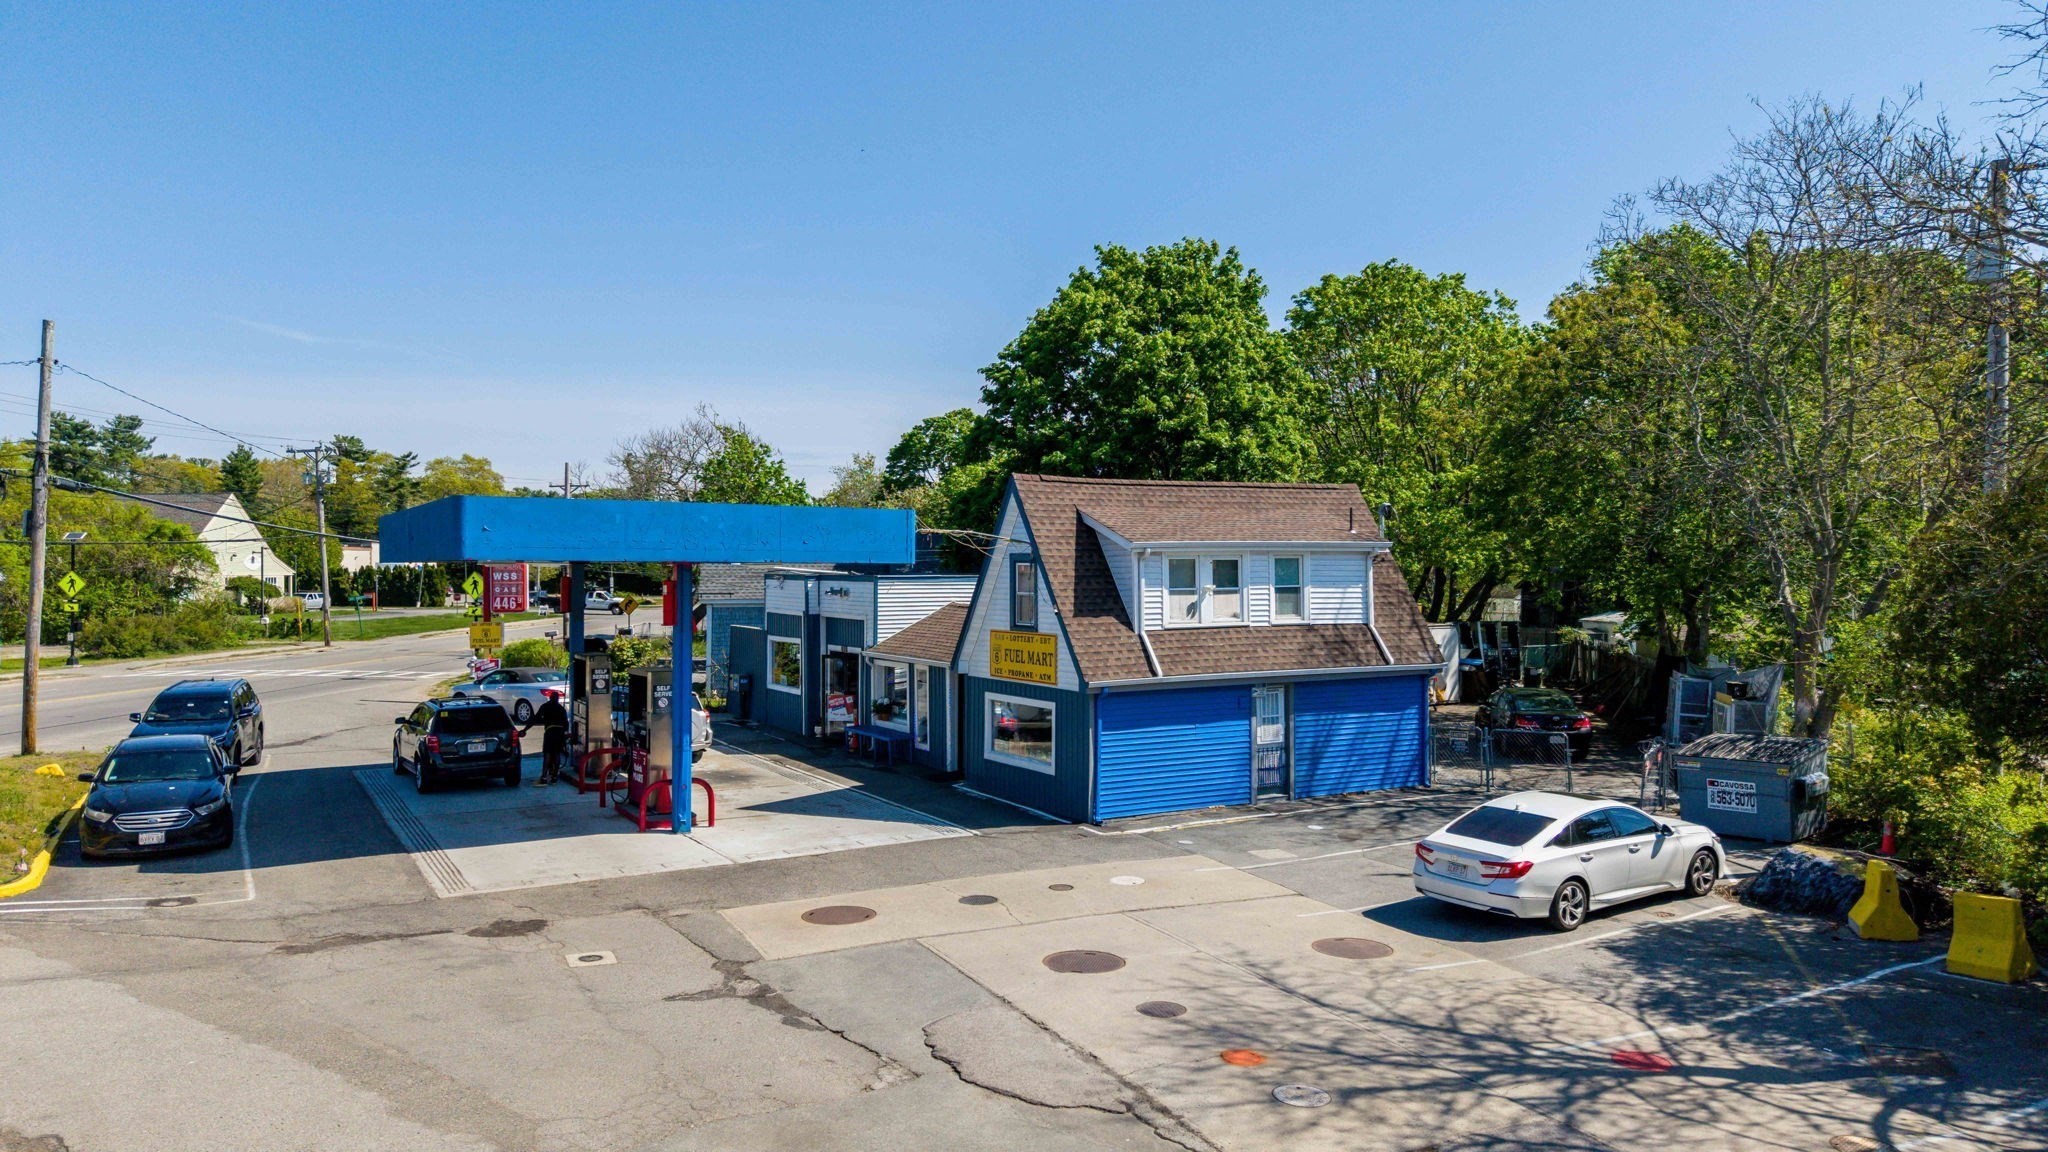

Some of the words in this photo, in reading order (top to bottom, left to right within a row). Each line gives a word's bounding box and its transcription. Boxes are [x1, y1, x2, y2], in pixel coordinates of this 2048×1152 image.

[1009, 635, 1034, 643] LOTTERY
[1004, 649, 1025, 664] FUEL
[1027, 650, 1054, 667] MART
[1008, 669, 1034, 678] PROPANE
[1040, 673, 1051, 681] ATM
[1719, 781, 1754, 790] CAVOSSA
[1716, 790, 1756, 808] 563-5070
